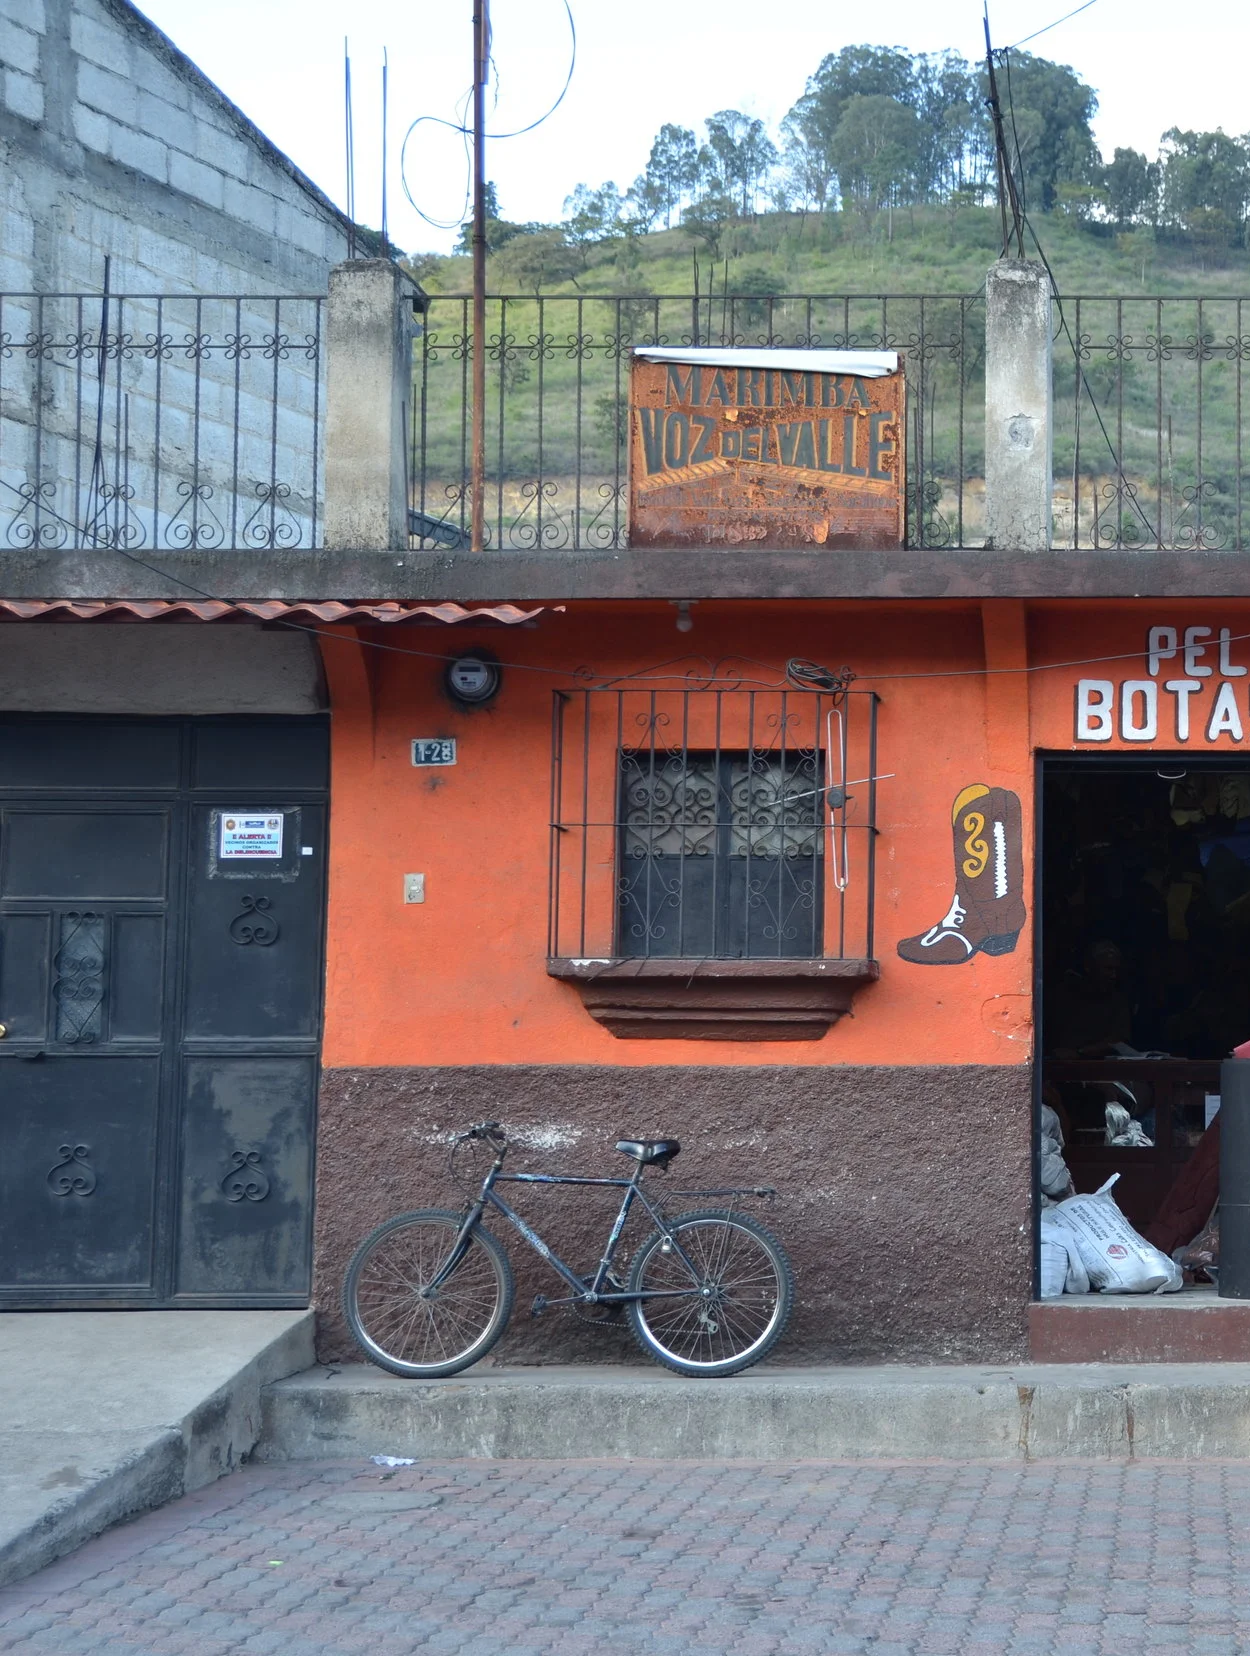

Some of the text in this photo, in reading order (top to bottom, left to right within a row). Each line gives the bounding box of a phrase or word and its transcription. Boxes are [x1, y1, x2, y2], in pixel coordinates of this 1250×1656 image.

[665, 365, 871, 408] MARIMBA
[636, 407, 896, 482] VOZ DEL VALLE
[419, 742, 452, 761] 1-28
